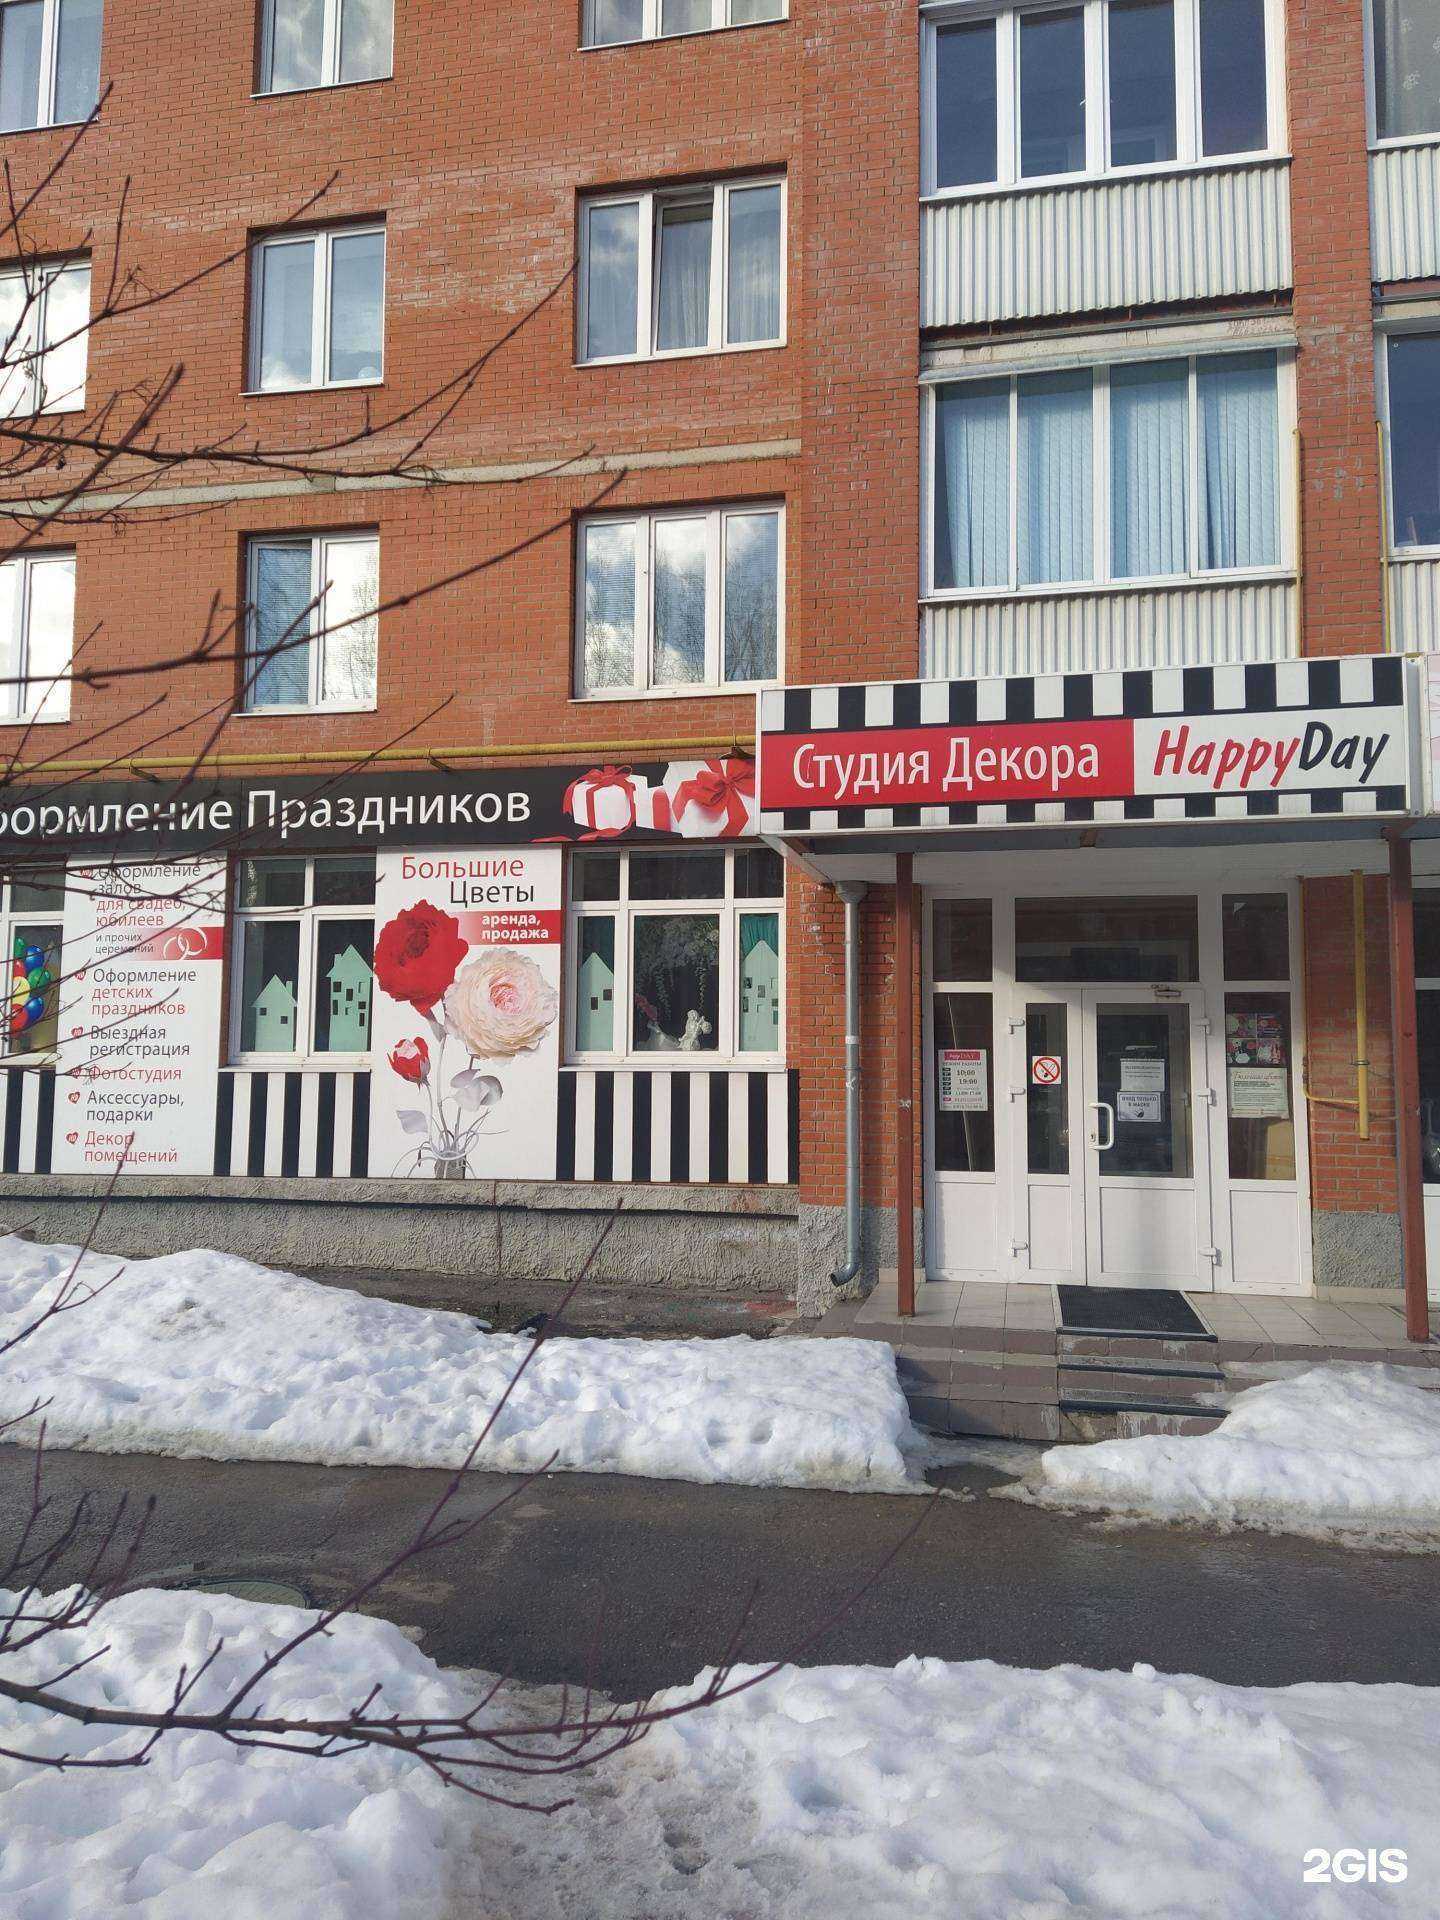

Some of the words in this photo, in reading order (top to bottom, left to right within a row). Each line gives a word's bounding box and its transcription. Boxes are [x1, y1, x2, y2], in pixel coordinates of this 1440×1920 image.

[793, 743, 930, 800] Студия
[942, 736, 1099, 792] Декора
[0, 800, 233, 840] ормление
[248, 790, 531, 838] Праздников
[402, 856, 525, 879] Большие
[450, 880, 534, 908] Цветы
[96, 900, 124, 912] для
[96, 912, 164, 927] юбилеев
[481, 914, 542, 928] аренда,
[95, 934, 102, 942] и
[105, 934, 143, 945] прочих
[481, 928, 549, 943] продажа
[93, 967, 197, 986] Оформление
[91, 987, 154, 1001] детских
[91, 1003, 186, 1019] праздников
[90, 1025, 167, 1042] Выездная
[89, 1044, 191, 1059] регистрация
[89, 1065, 182, 1083] Фотостудия
[86, 1090, 185, 1107] Аксессуары,
[86, 1110, 154, 1125] подарки
[84, 1130, 134, 1149] Декор
[84, 1147, 178, 1164] помещений
